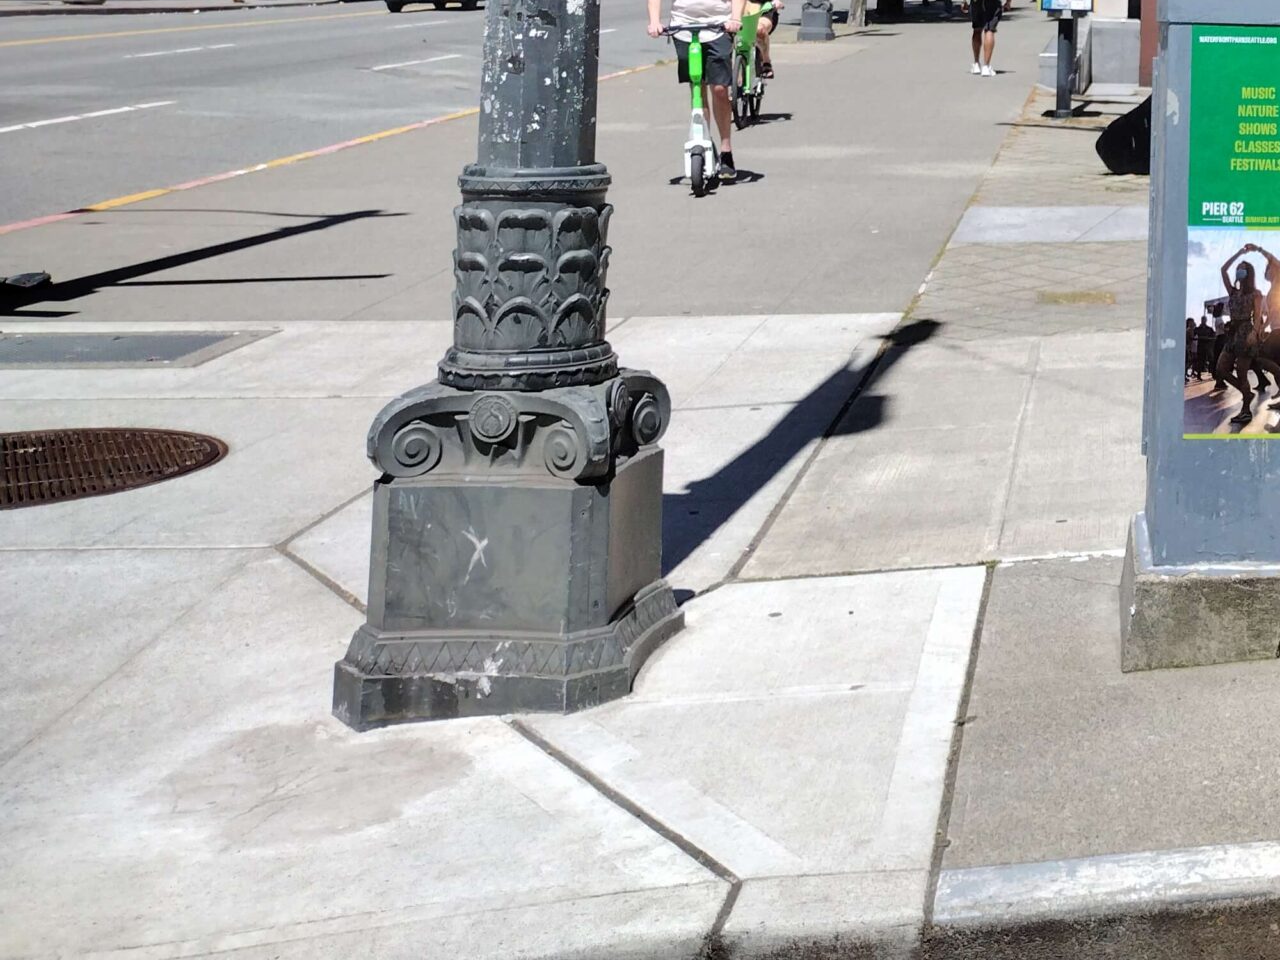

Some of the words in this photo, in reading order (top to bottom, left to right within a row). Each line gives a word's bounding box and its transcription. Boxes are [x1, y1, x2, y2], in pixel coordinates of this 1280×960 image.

[1241, 87, 1276, 99] MUSIC
[1238, 105, 1279, 117] NATURE
[1238, 123, 1277, 135] SHOWS
[1234, 141, 1280, 153] CLASSES
[1202, 202, 1228, 215] PIER
[1229, 202, 1244, 215] 62
